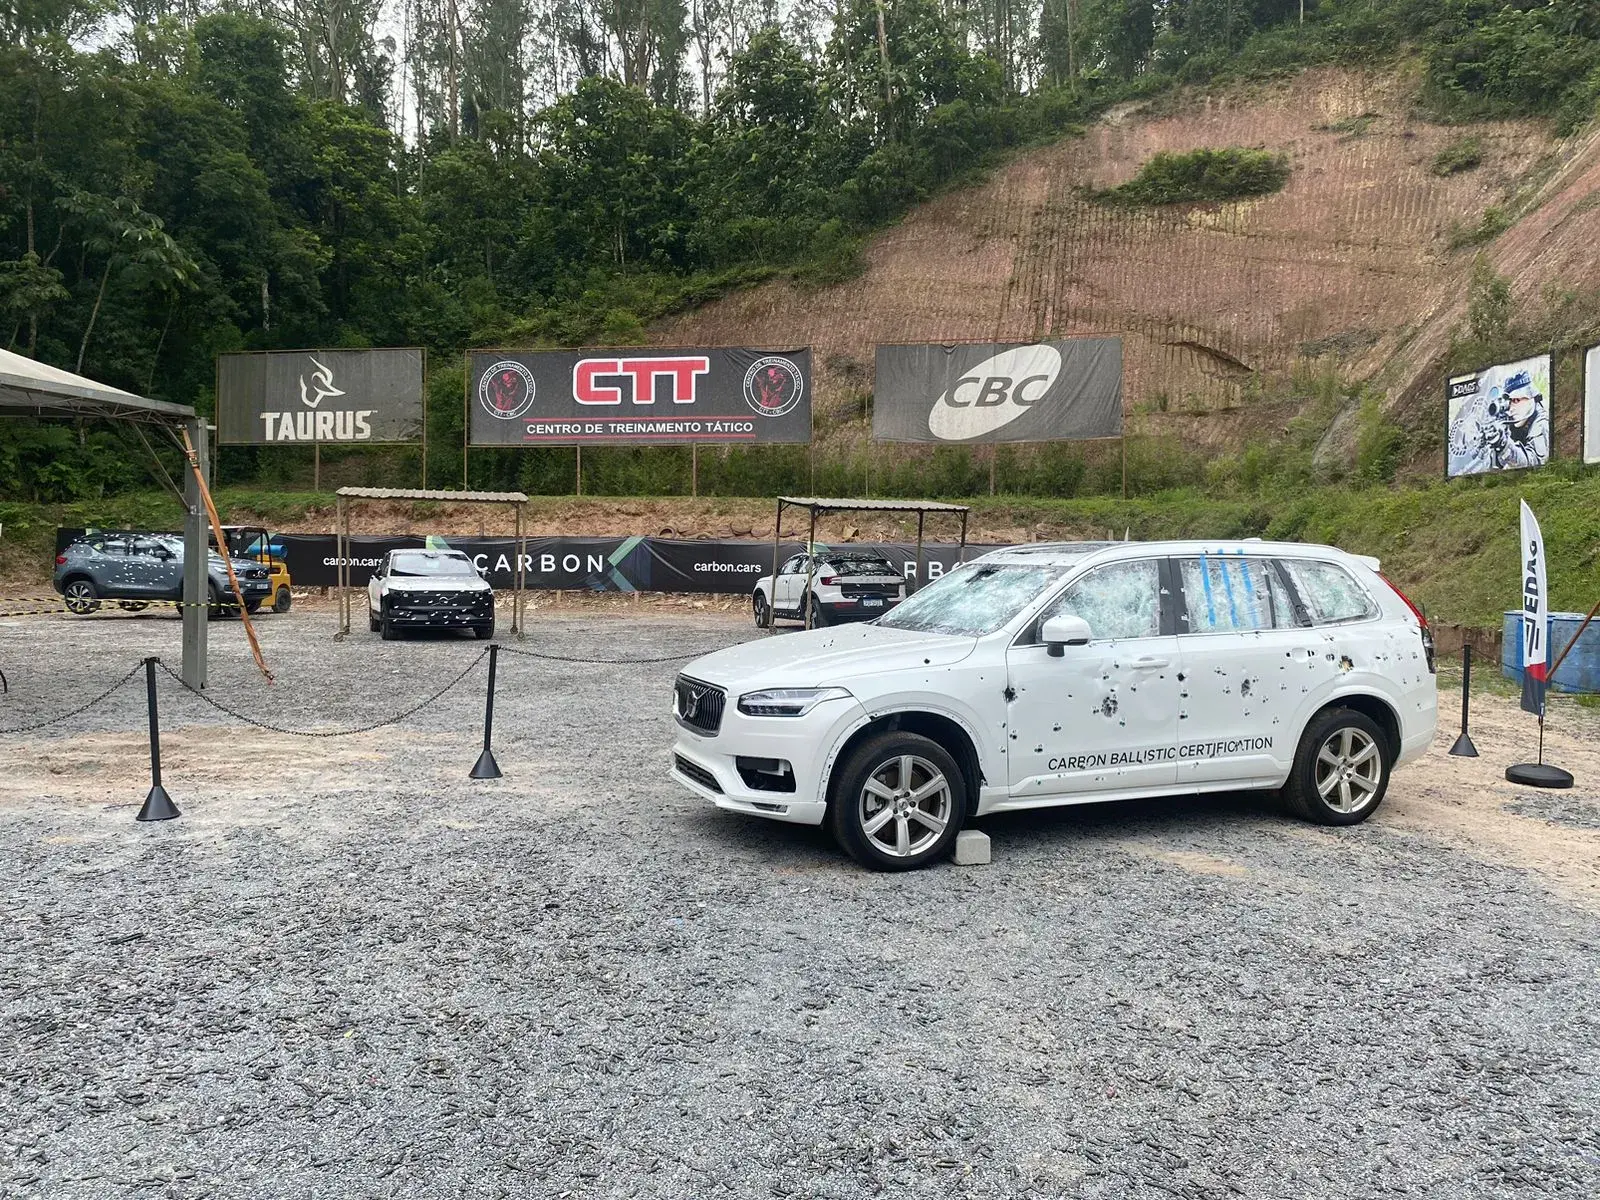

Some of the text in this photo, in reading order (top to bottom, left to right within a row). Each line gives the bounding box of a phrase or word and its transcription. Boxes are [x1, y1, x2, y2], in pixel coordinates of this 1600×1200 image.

[573, 356, 709, 405] CTT
[944, 374, 1049, 408] CBC
[260, 410, 371, 440] TAURUS
[526, 420, 753, 434] CENTRO DE TREINAMENTO TÁTICO
[473, 553, 604, 573] CARBON
[693, 560, 762, 573] carbon.cars
[1048, 736, 1273, 770] CARBON BALLISTIC CERTIFICATION
